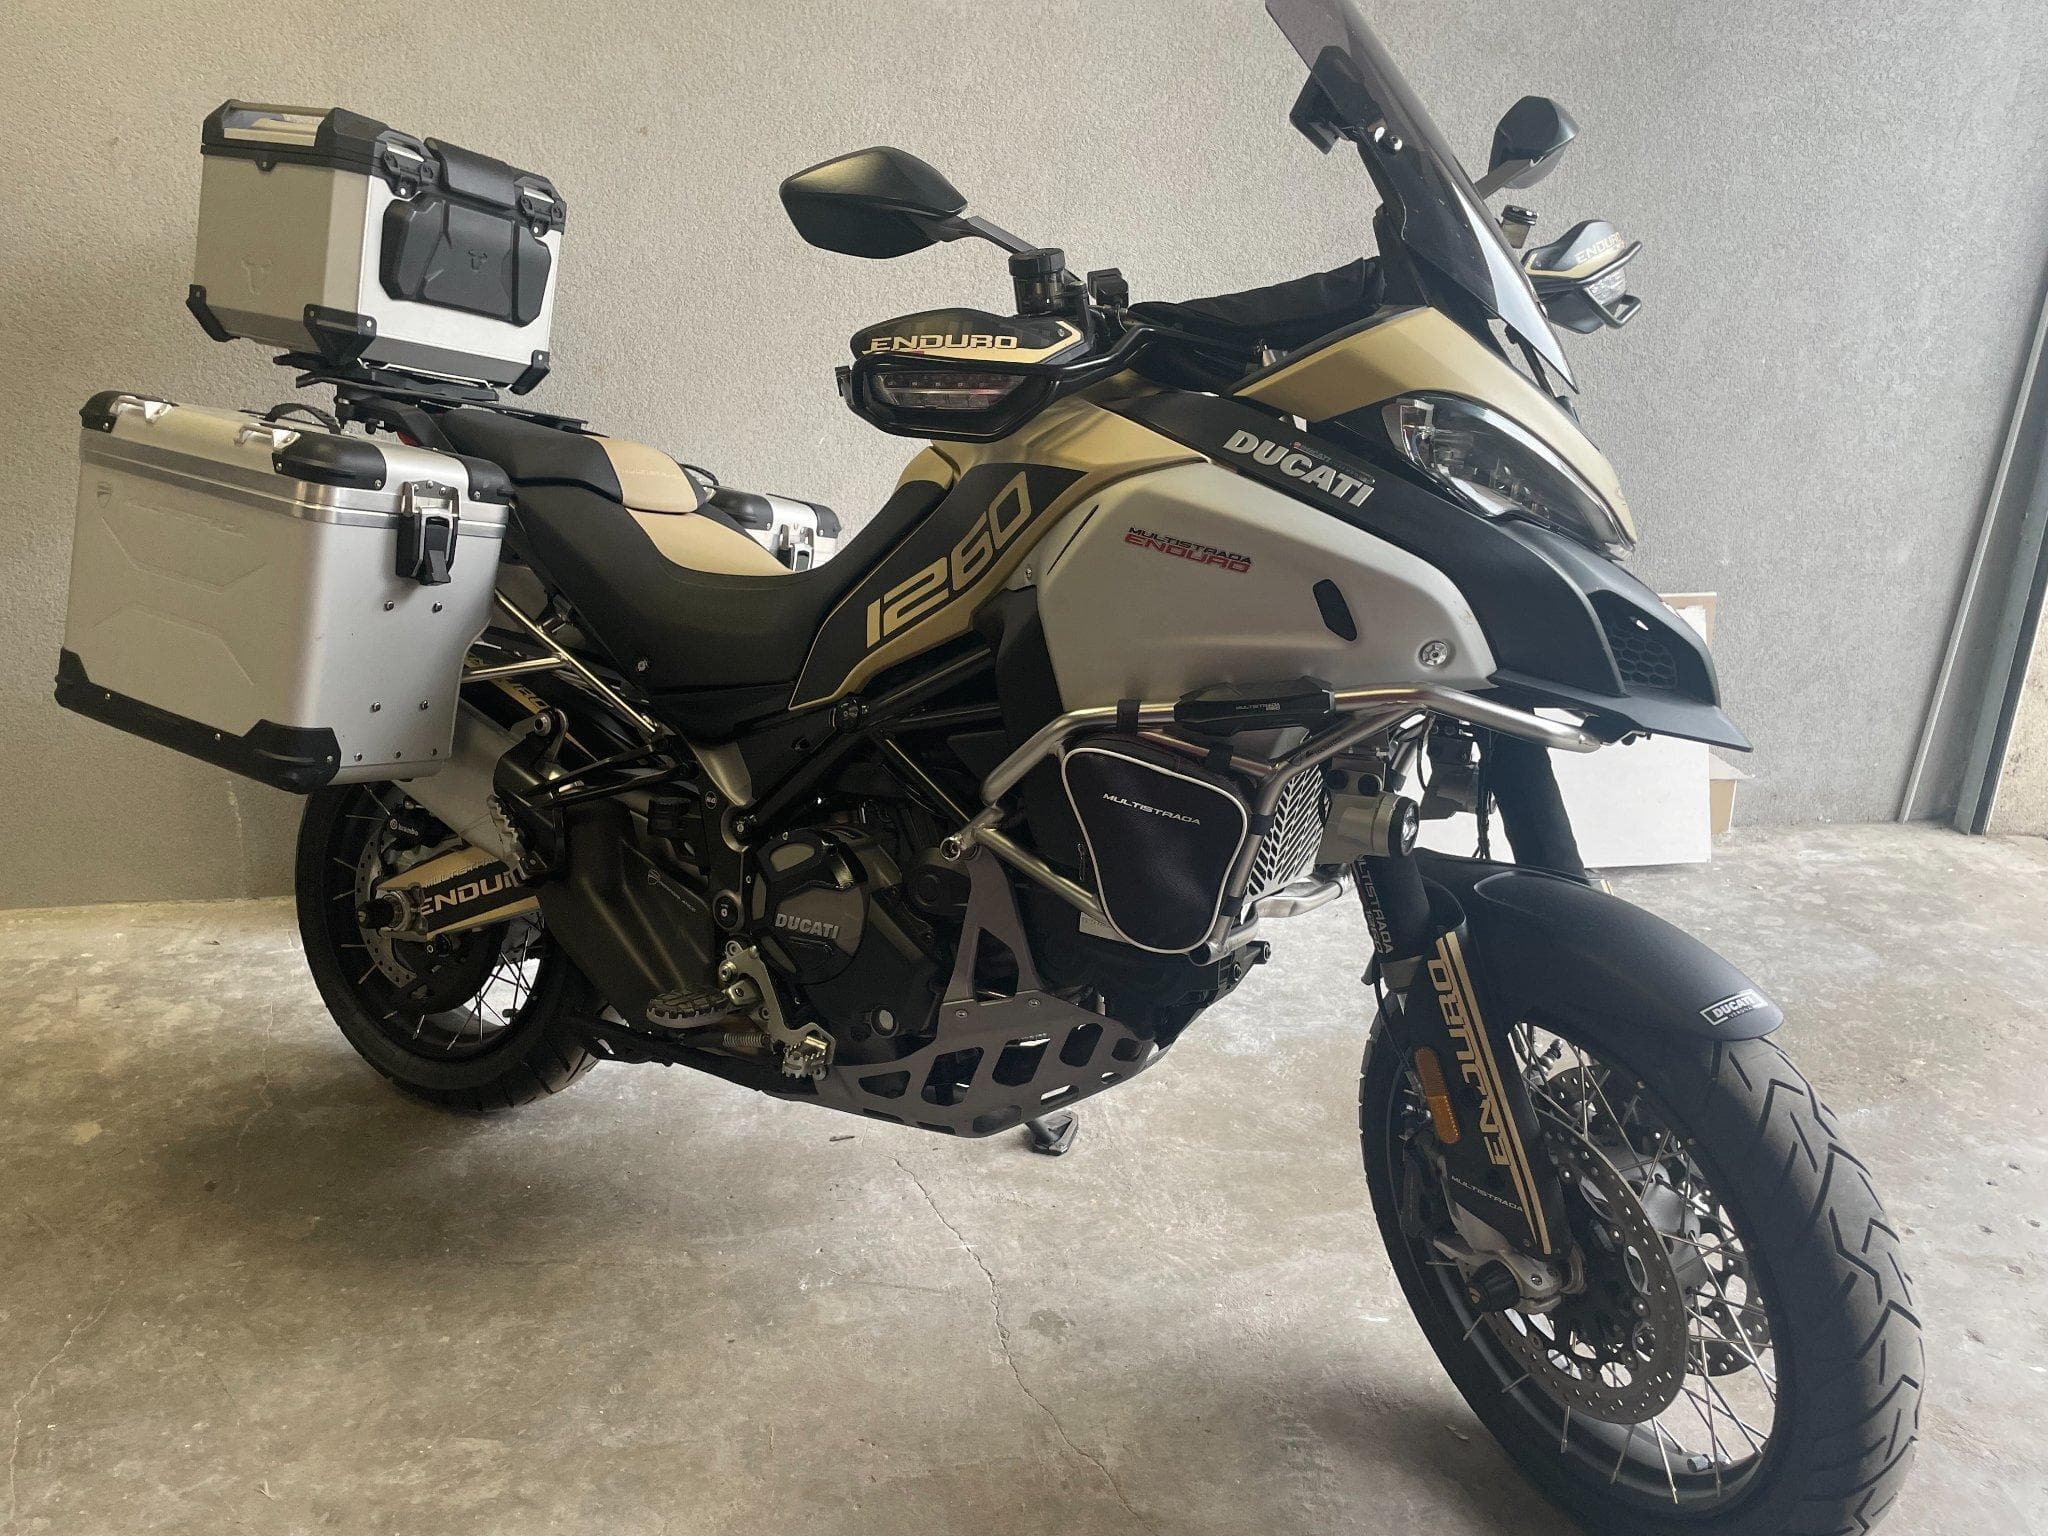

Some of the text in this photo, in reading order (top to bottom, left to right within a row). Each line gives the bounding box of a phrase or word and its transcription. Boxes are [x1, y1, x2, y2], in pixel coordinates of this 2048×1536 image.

[870, 334, 1018, 352] ENDURO
[1222, 429, 1375, 507] DUCATI
[866, 470, 1032, 649] 1260
[1124, 533, 1251, 573] ENDURO
[1128, 526, 1252, 564] MULTISTRADA
[1102, 793, 1200, 825] MULTISTRADA
[774, 913, 840, 939] DUCATI
[1427, 959, 1511, 1166] ENDURO
[1451, 1175, 1523, 1212] MULTISTRADA
